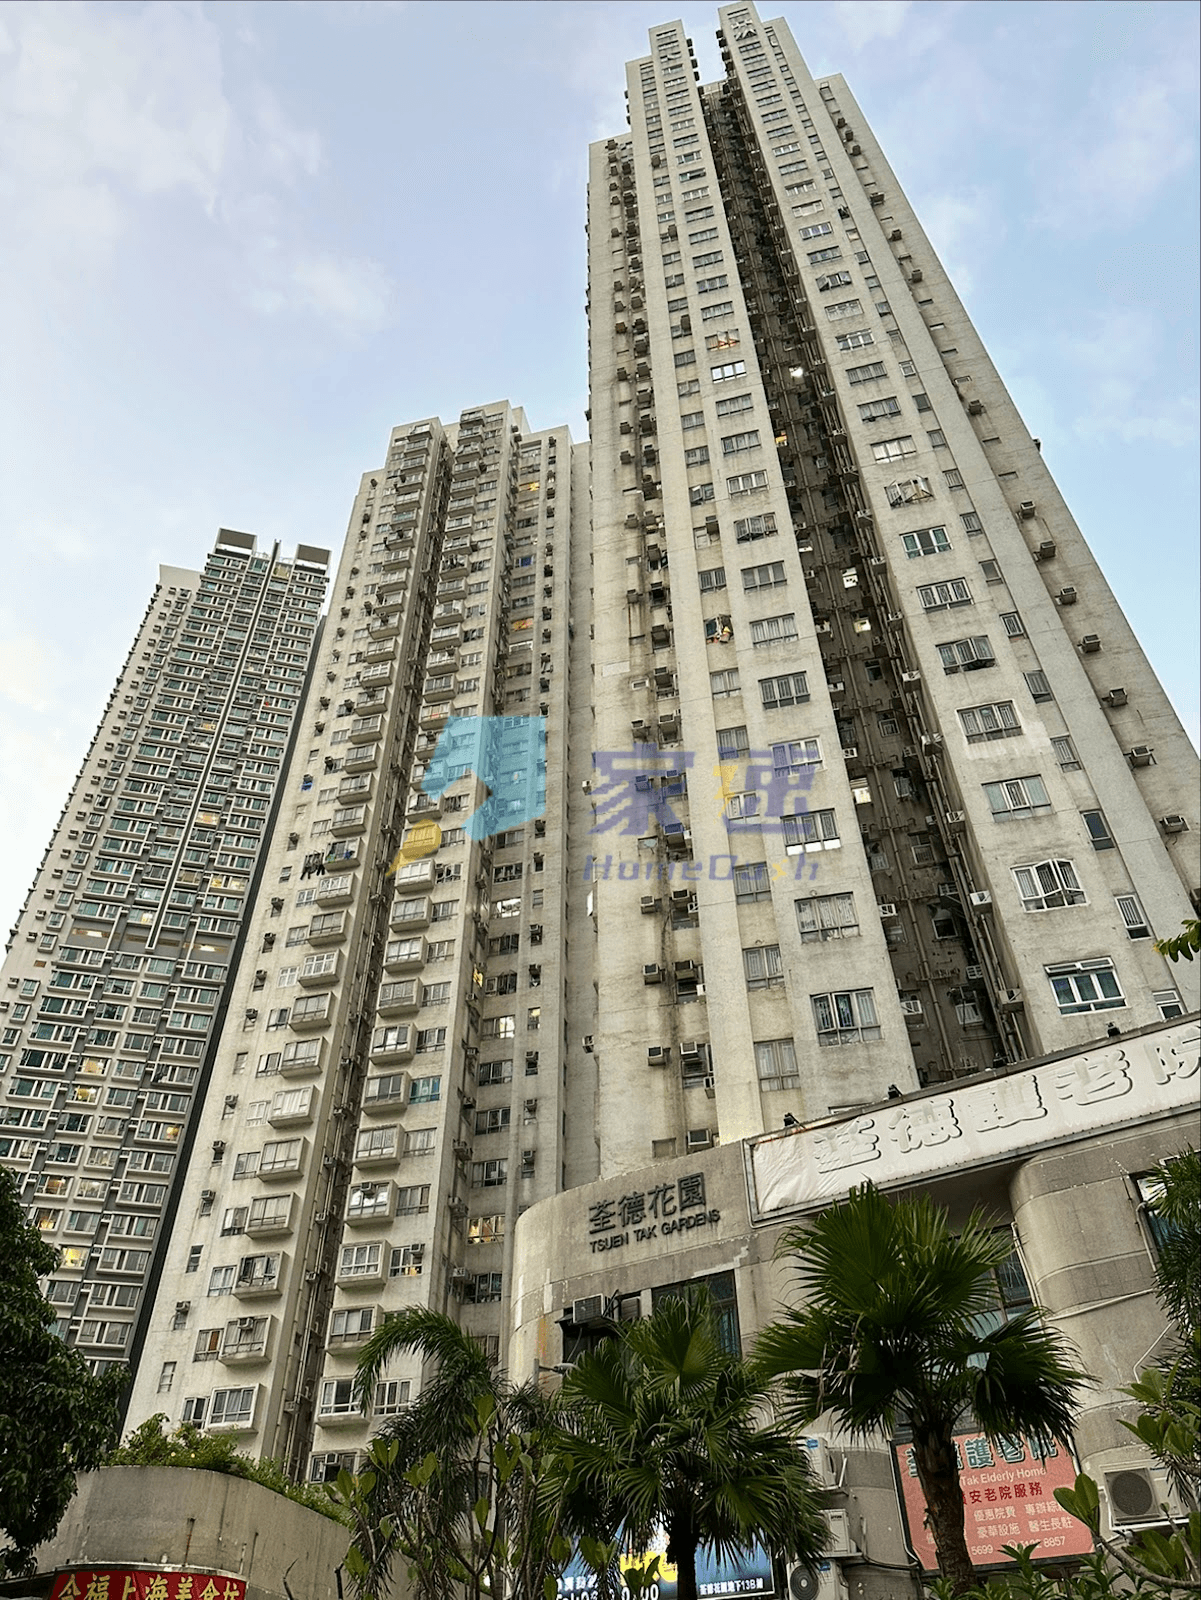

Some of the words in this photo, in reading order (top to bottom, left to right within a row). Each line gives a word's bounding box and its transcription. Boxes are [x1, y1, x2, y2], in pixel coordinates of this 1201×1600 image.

[589, 1172, 706, 1234] 荃德花園
[589, 1232, 629, 1253] TSUEN
[633, 1224, 657, 1242] TAK
[661, 1209, 721, 1235] GARDENS
[961, 1475, 979, 1487] Tak
[980, 1469, 1015, 1485] Elderly
[1016, 1467, 1047, 1479] Home
[1028, 1516, 1073, 1533] 醫生長駐
[971, 1544, 993, 1555] 5699
[1043, 1535, 1065, 1547] 8857
